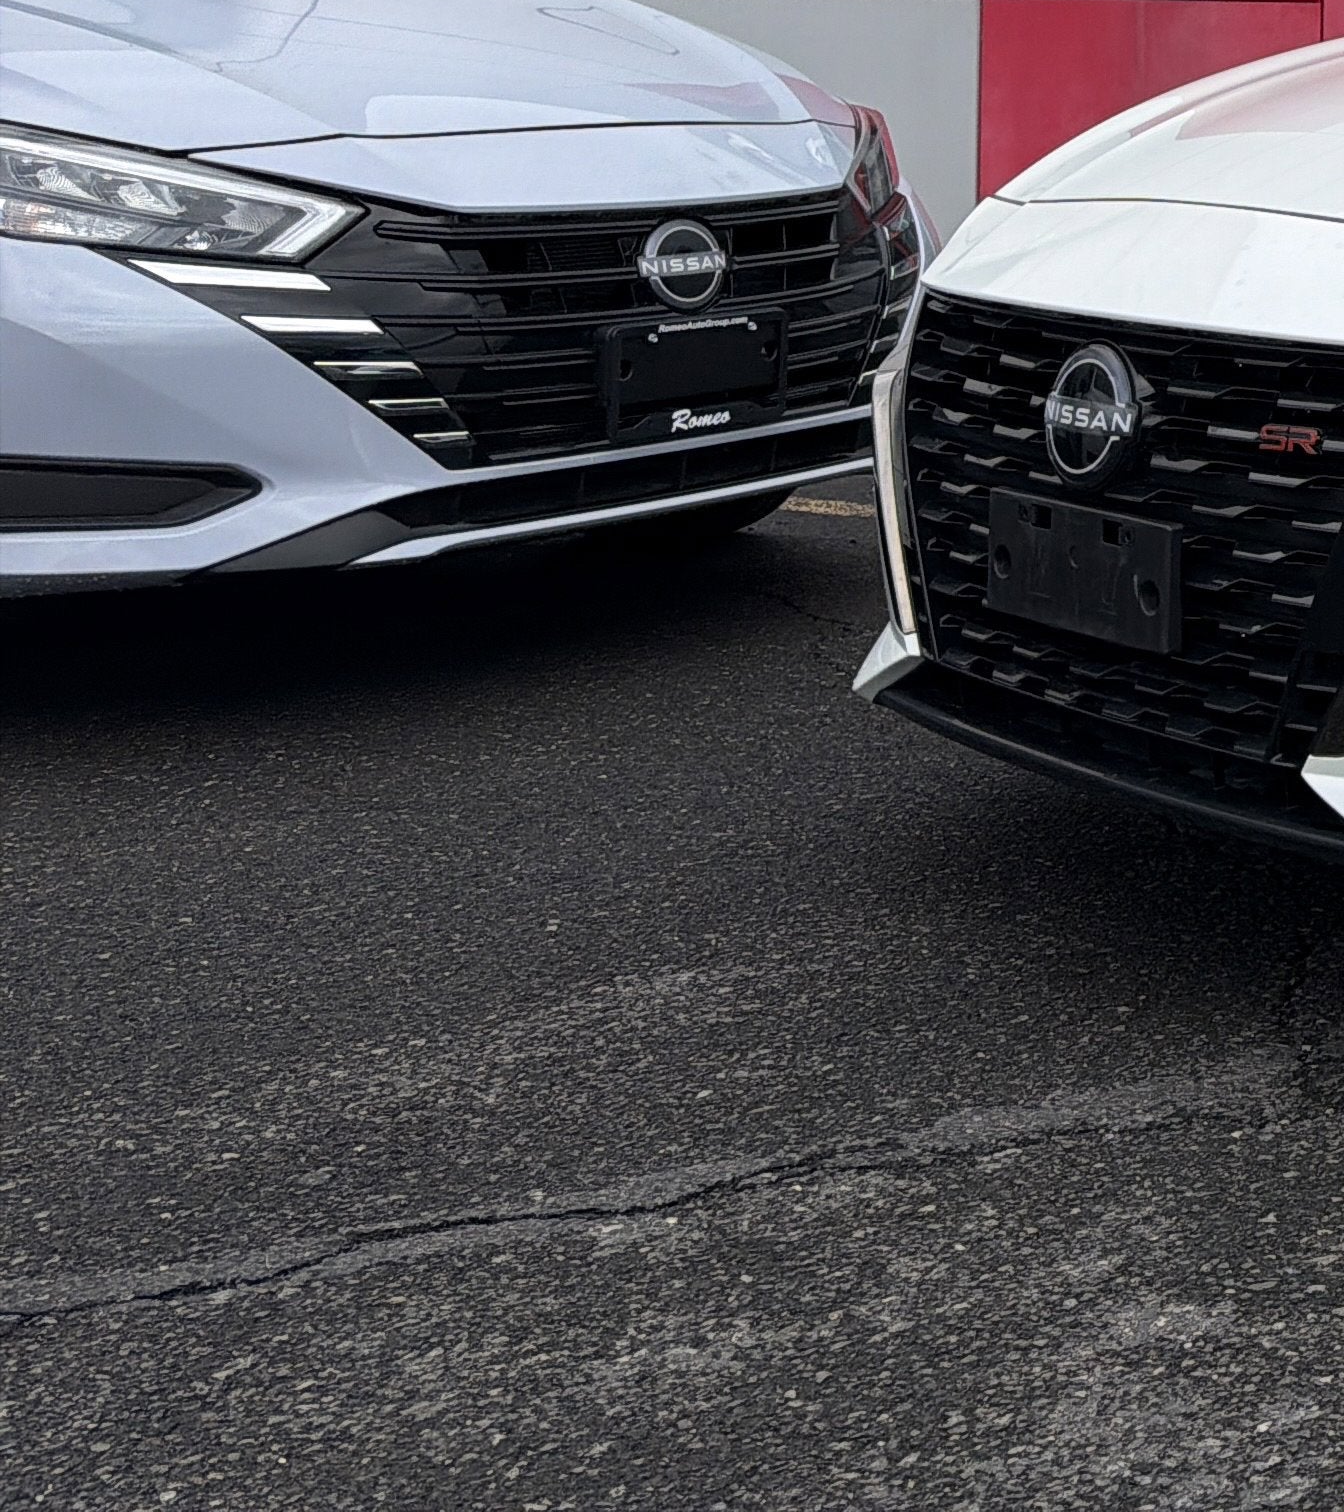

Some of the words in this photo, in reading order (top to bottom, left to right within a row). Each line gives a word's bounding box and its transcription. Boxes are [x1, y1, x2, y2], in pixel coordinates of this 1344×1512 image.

[641, 253, 726, 275] NISSAN
[658, 316, 748, 333] RomeoAutoGroup.com
[671, 408, 731, 433] Romeo
[1046, 399, 1132, 433] NISSAN
[1259, 424, 1319, 455] SR
